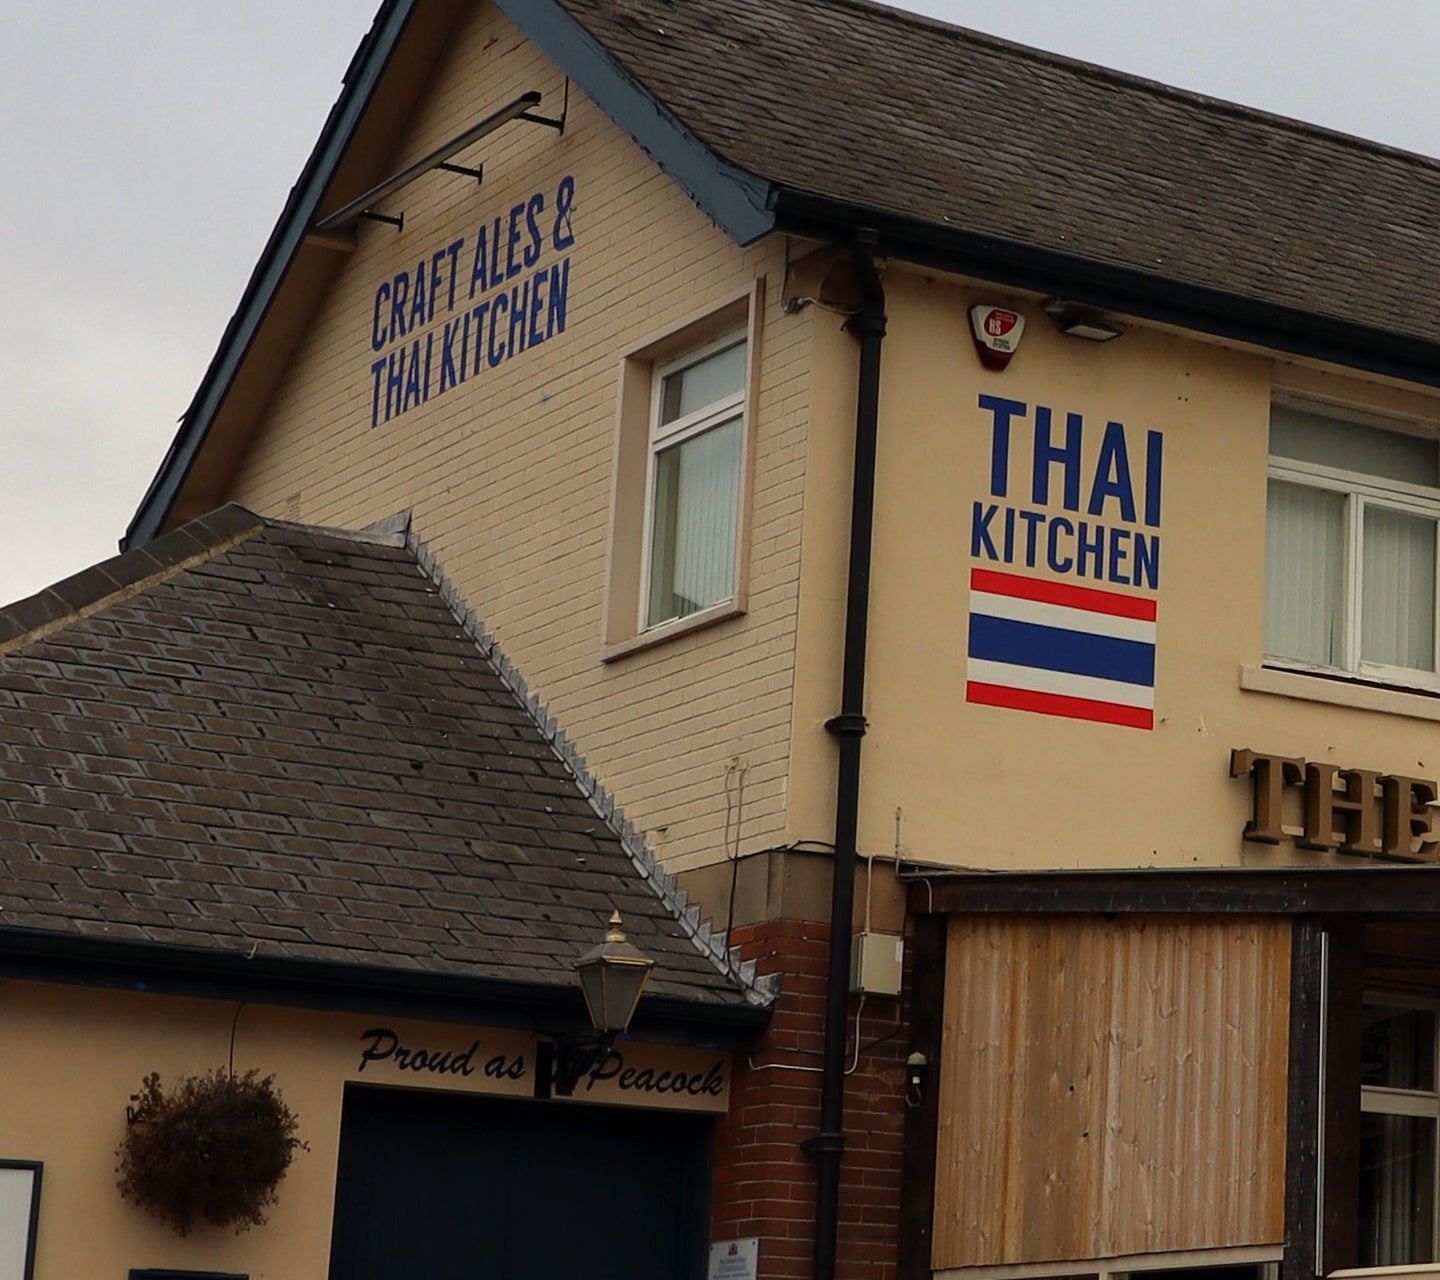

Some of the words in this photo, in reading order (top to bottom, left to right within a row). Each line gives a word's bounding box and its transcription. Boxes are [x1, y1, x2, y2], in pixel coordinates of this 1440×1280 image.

[372, 238, 464, 351] CRAFT
[469, 193, 544, 299] ALES
[553, 176, 576, 251] &
[371, 333, 434, 429] THAI
[440, 258, 570, 394] KITCHEN
[978, 394, 1163, 528] THAI
[971, 501, 1160, 590] KITCHEN
[360, 1029, 480, 1076] Proud
[484, 1055, 526, 1080] as
[586, 1050, 726, 1096] Peacock
